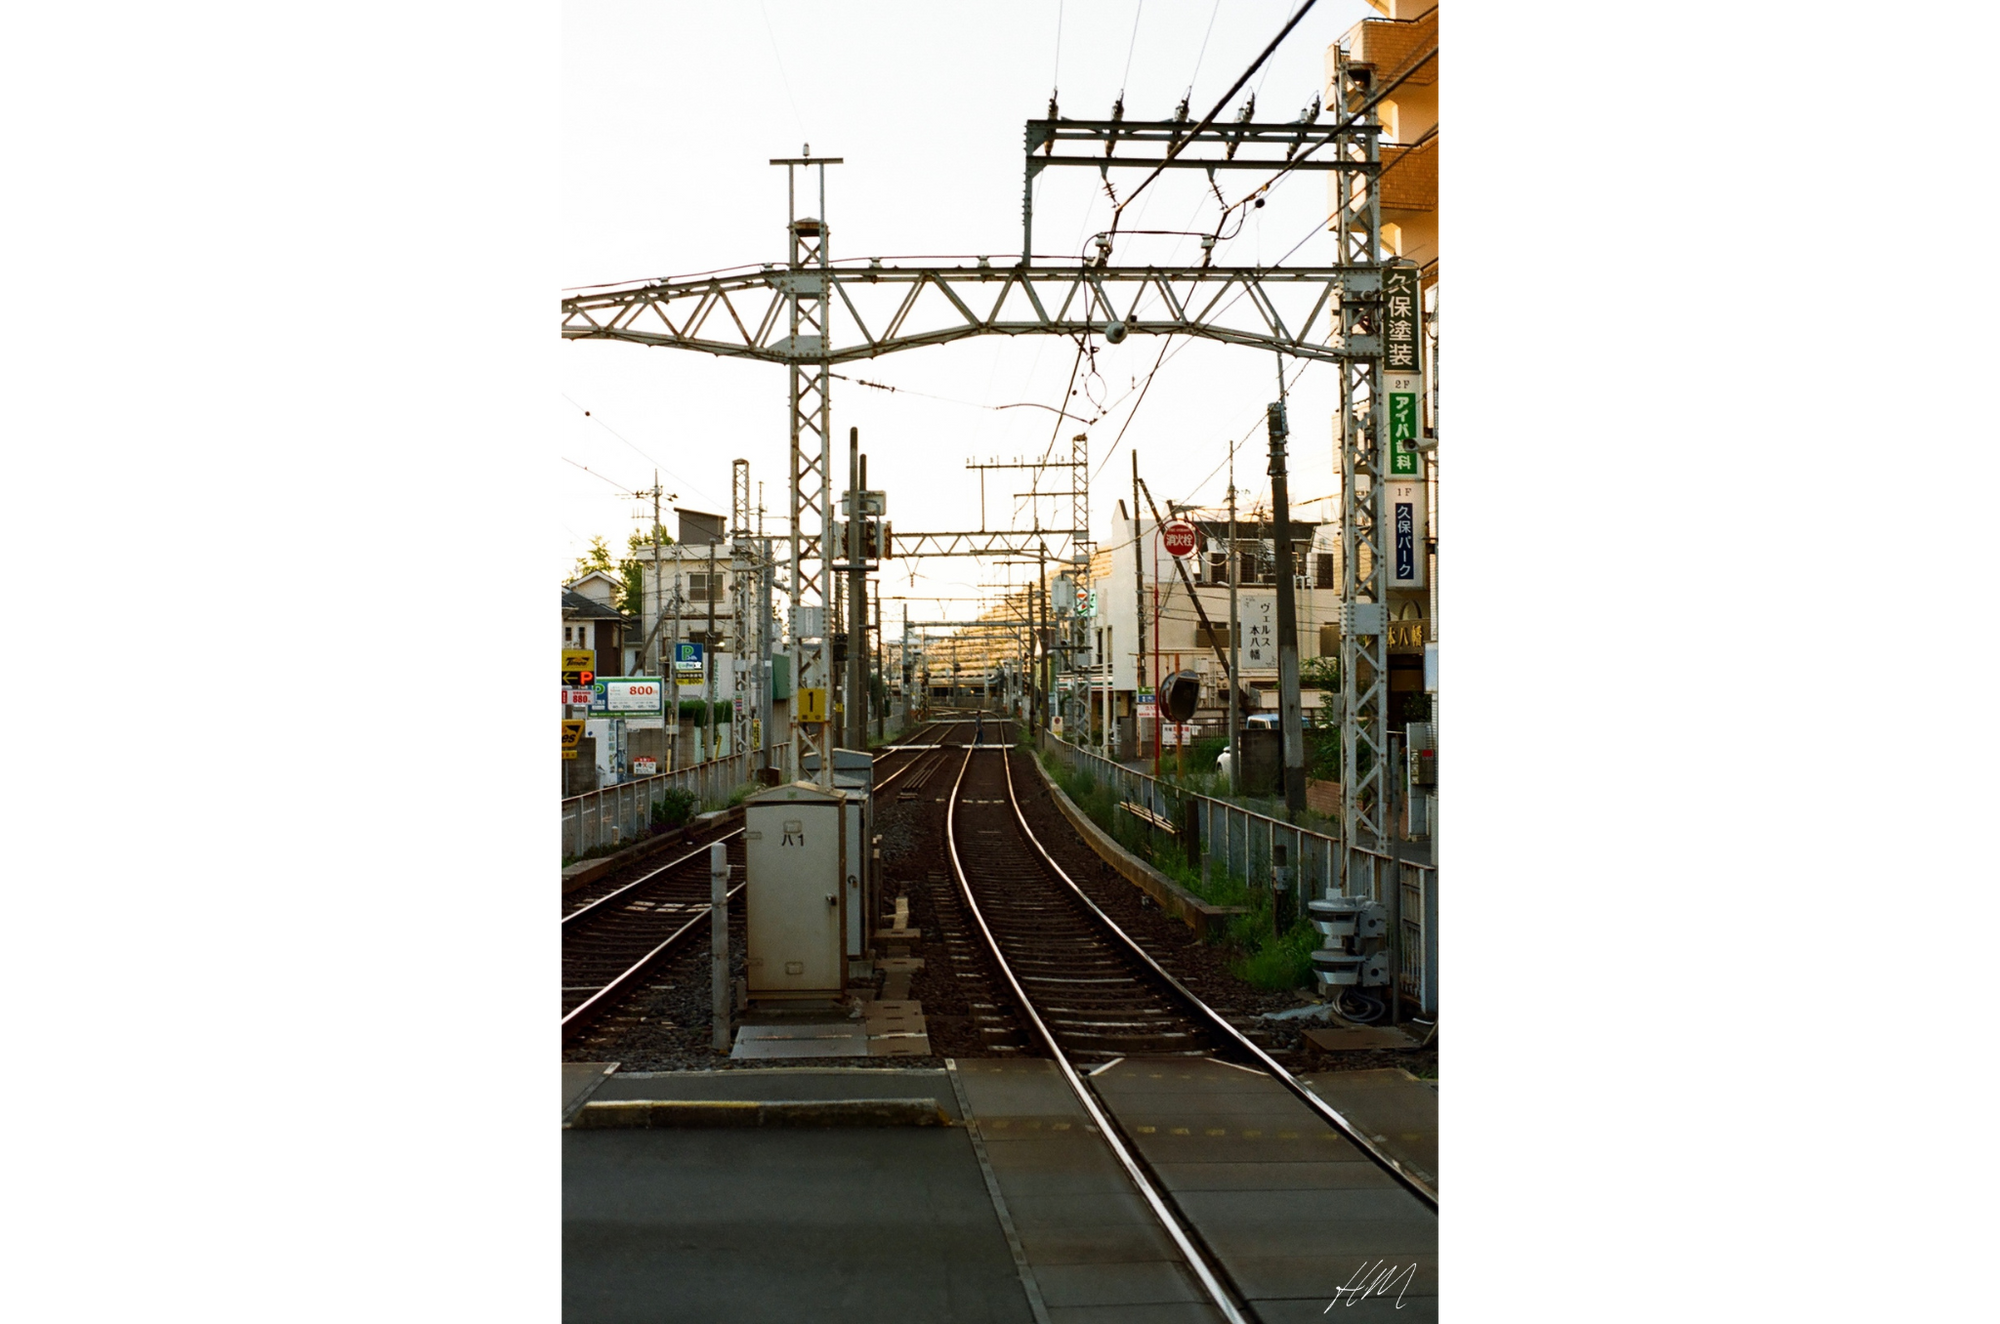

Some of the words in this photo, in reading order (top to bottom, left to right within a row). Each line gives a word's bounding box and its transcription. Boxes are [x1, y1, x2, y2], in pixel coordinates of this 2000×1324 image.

[1387, 273, 1413, 366] 久保塗装
[1394, 379, 1410, 389] 2F
[1397, 488, 1412, 497] 1F
[1166, 533, 1193, 547] 消火栓
[1397, 505, 1412, 577] 久保パーク
[1260, 602, 1271, 647] ヴェルス
[1249, 624, 1261, 660] 本八幡
[681, 645, 695, 661] P
[566, 657, 590, 667] Times
[580, 671, 593, 685] P
[629, 686, 653, 695] 800
[573, 695, 588, 703] 880
[808, 691, 813, 712] 1
